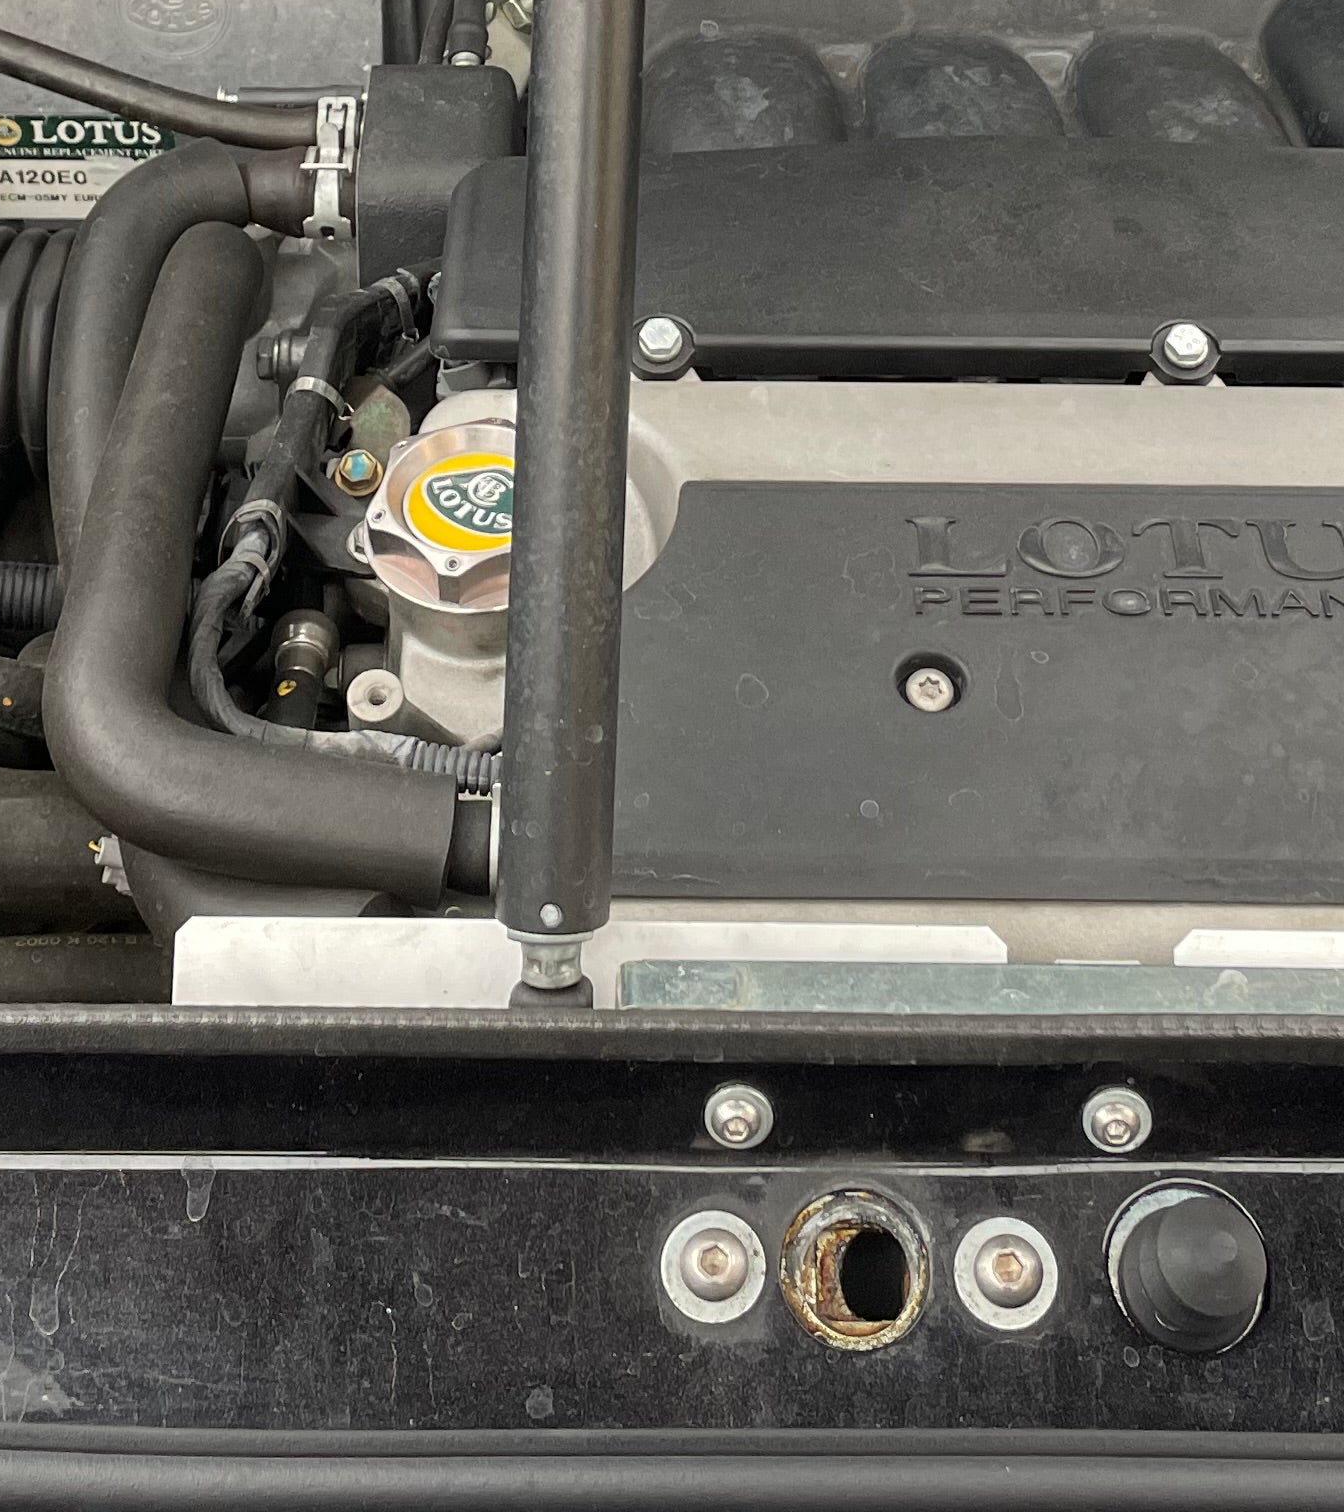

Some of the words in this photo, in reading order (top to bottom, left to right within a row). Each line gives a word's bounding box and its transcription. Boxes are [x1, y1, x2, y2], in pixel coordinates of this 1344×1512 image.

[30, 119, 162, 145] LOTUS
[43, 147, 131, 158] REPLACEMENT
[431, 477, 514, 530] LOTUS
